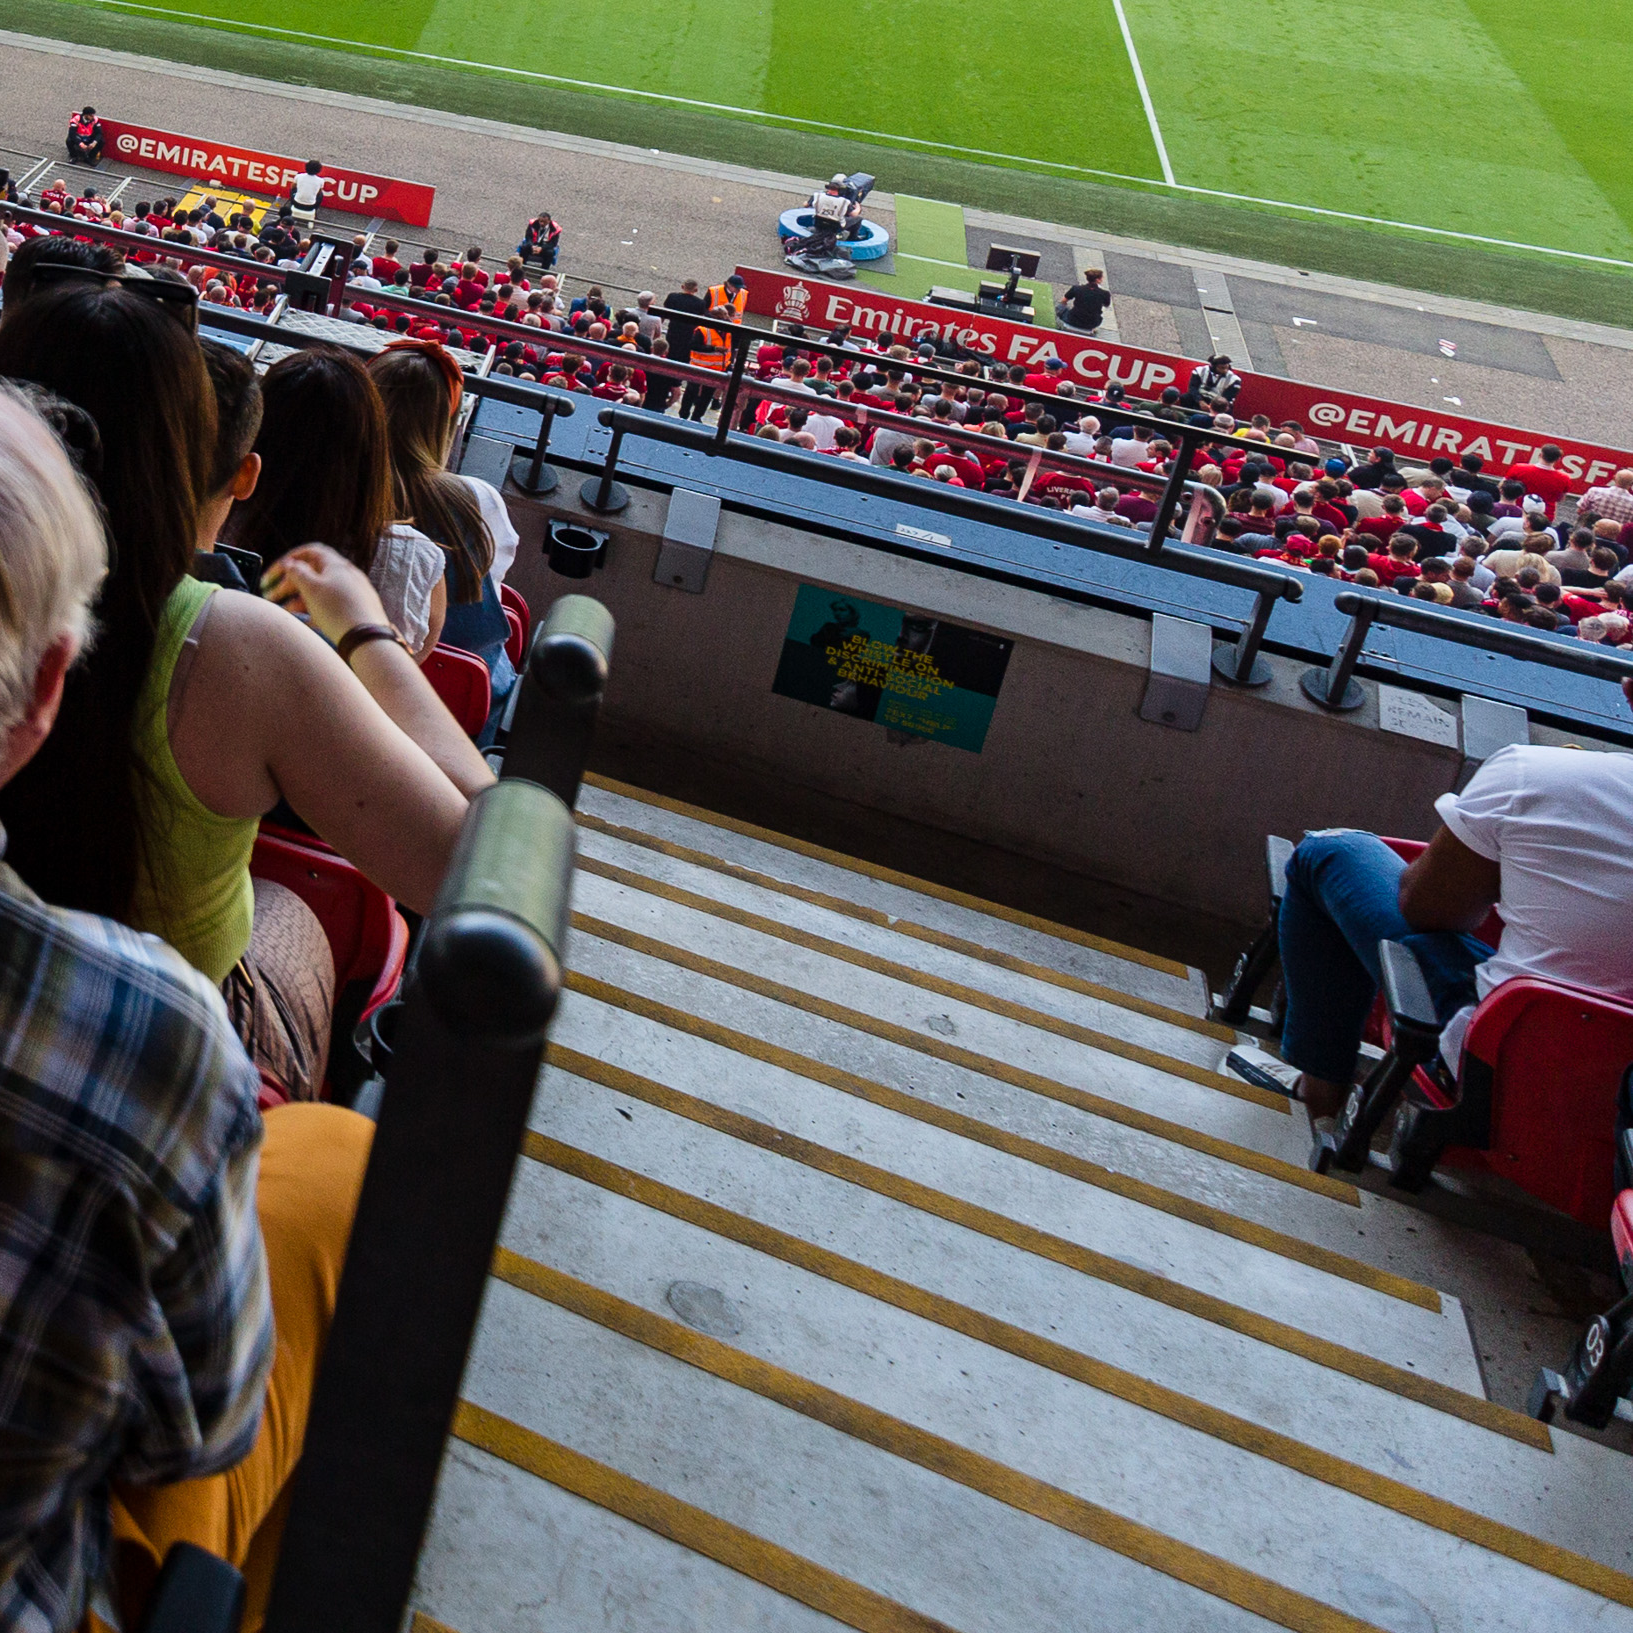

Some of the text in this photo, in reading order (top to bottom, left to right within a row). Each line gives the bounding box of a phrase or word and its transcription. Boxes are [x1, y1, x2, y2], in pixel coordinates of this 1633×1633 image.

[116, 133, 379, 204] @EMIRATESFCUP
[821, 208, 835, 217] 253
[825, 294, 1177, 392] Emirates FA CUP
[1308, 402, 1632, 486] @EMIRATSF
[825, 646, 954, 690] DISCRIMINATION
[842, 640, 940, 676] WHISTLE ON
[850, 635, 934, 666] BLOW THE
[827, 657, 942, 696] & ANTI-SOCIAL
[837, 669, 929, 701] BEHAVIOUR
